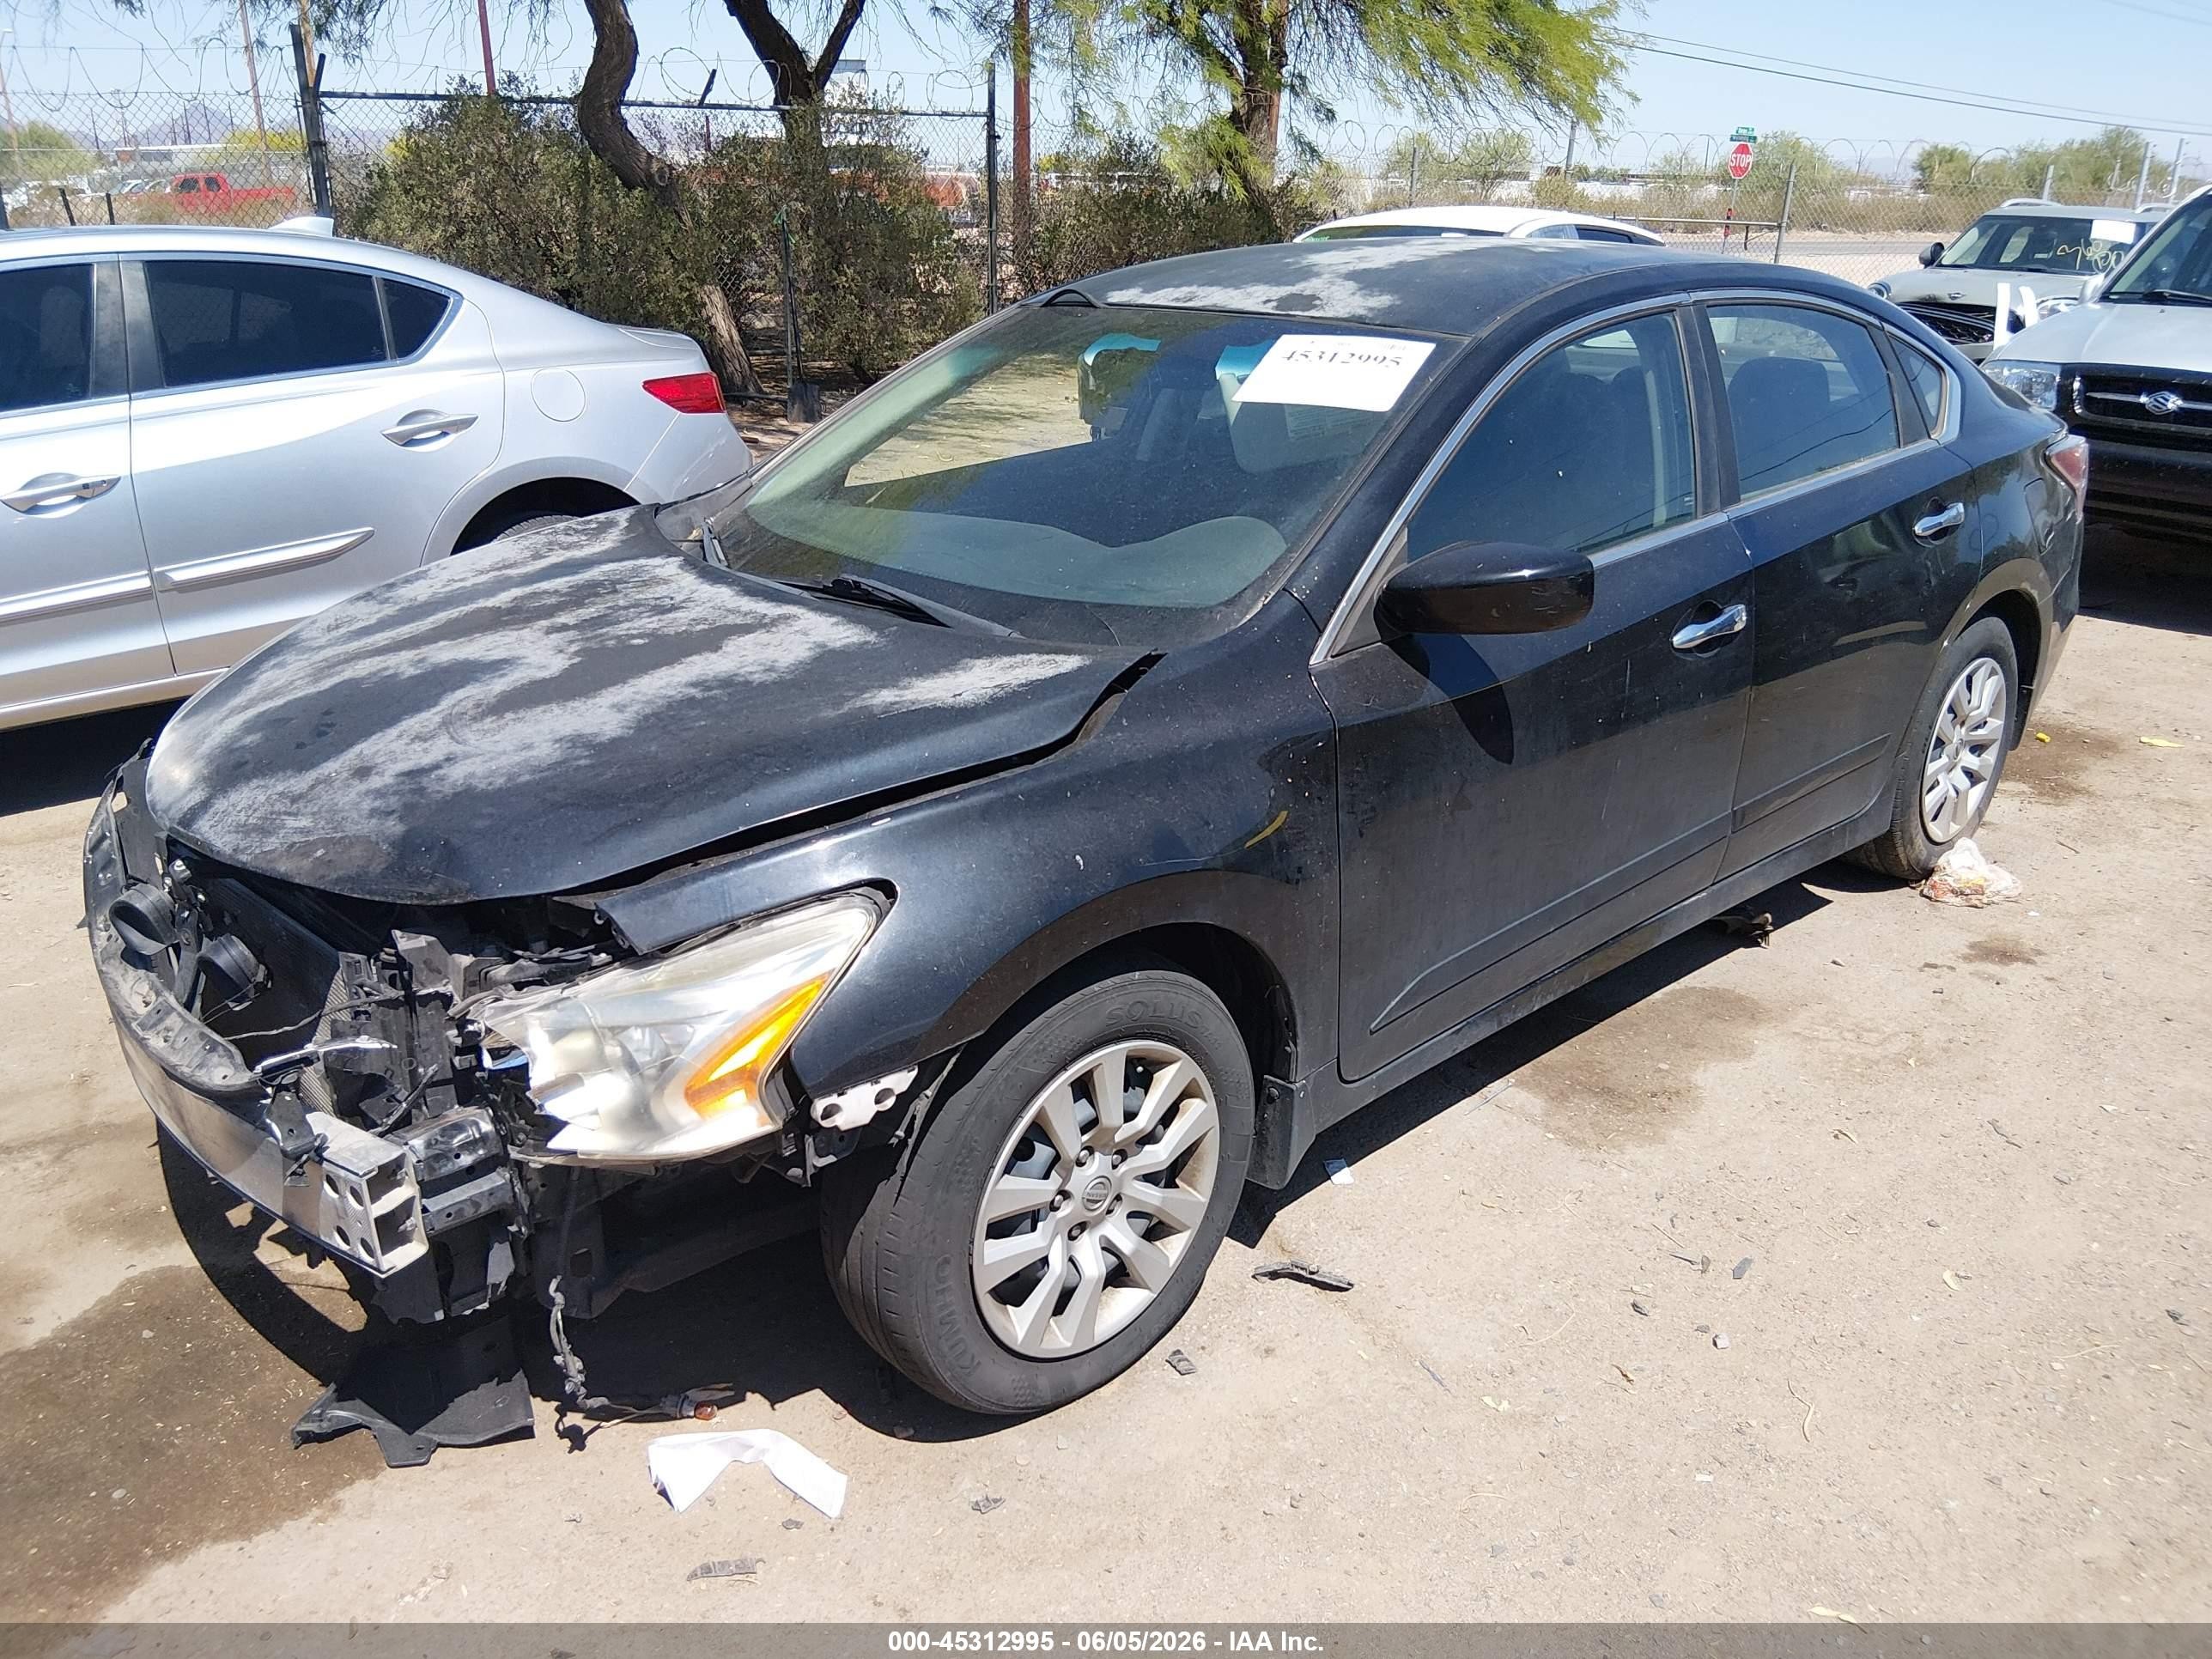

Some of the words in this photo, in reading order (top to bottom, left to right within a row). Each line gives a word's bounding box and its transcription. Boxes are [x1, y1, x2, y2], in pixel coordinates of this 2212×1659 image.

[1730, 154, 1752, 168] STOP
[1281, 349, 1402, 368] 45312995
[1105, 1000, 1203, 1029] SOLUS
[934, 1253, 981, 1376] KUMHO
